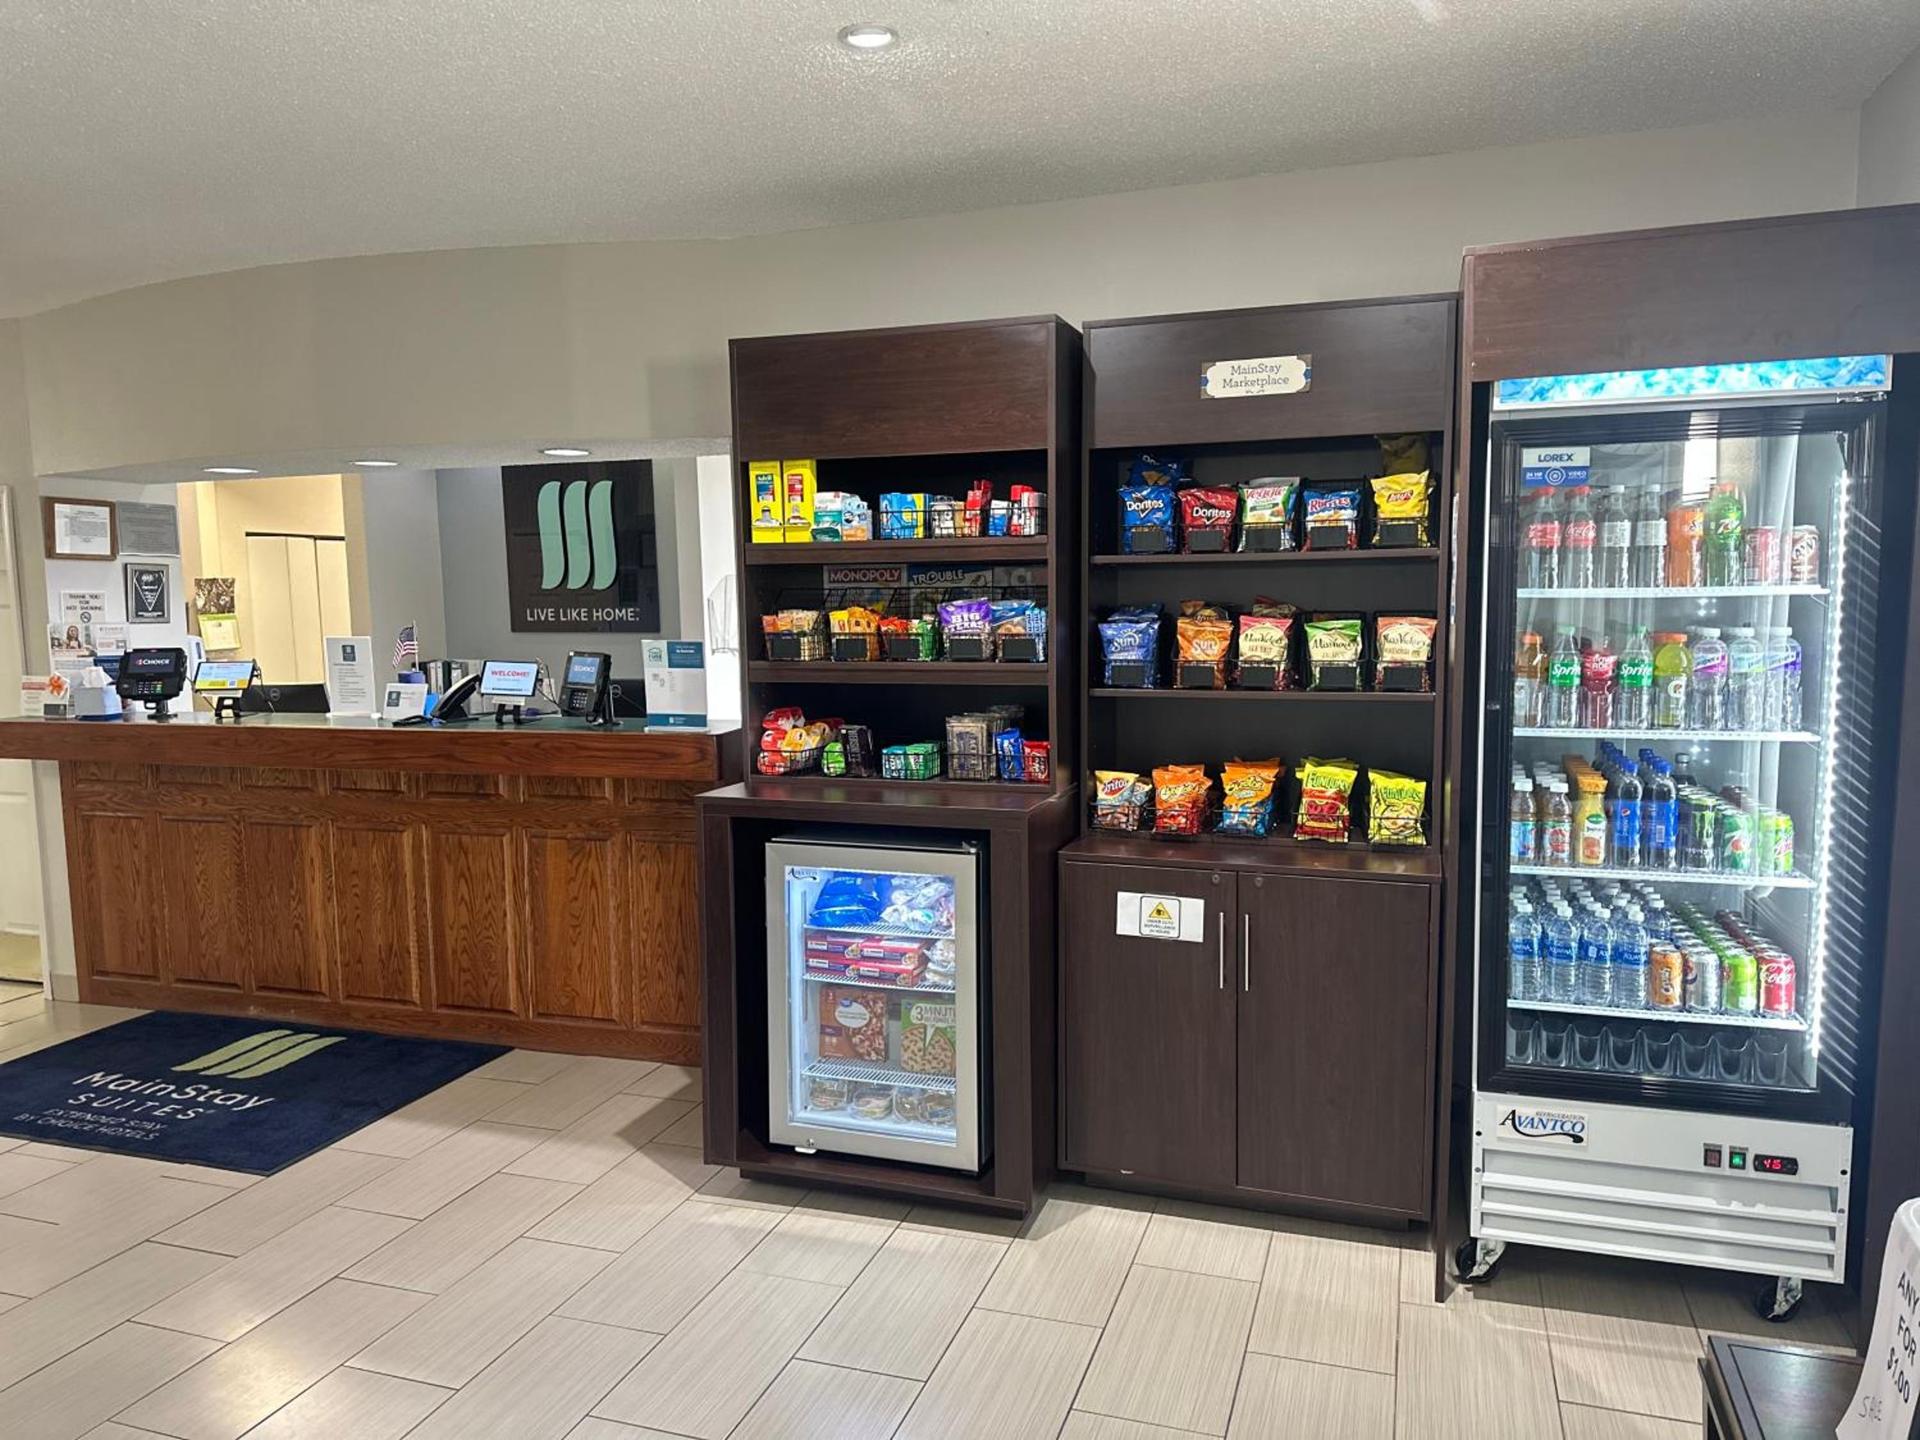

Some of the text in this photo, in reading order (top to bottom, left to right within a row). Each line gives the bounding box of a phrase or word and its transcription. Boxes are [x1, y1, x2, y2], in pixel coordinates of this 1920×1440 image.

[1231, 363, 1281, 376] MainStay
[1222, 375, 1290, 389] Marketplace
[1538, 453, 1574, 463] LOREX
[1126, 498, 1164, 512] Doritos
[1192, 506, 1232, 519] Doritos
[829, 568, 900, 582] MONOPOLY
[912, 569, 966, 586] TROUBLE
[526, 608, 555, 621] LIVE
[560, 608, 589, 621] LIKE
[951, 611, 981, 625] BIG
[1111, 634, 1137, 652] Sun
[1192, 639, 1217, 653] Sun
[915, 1005, 924, 1022] 3
[72, 1070, 275, 1112] MainStay
[68, 1092, 206, 1120] SUITES
[13, 1113, 161, 1141] BY CHOICE HOTELS
[43, 1108, 168, 1131] EXTENDED STAY
[1498, 1109, 1586, 1135] AVANTCO
[1898, 1271, 1920, 1315] ANY
[1897, 1315, 1918, 1367] FOR
[1887, 1347, 1911, 1404] $1.00
